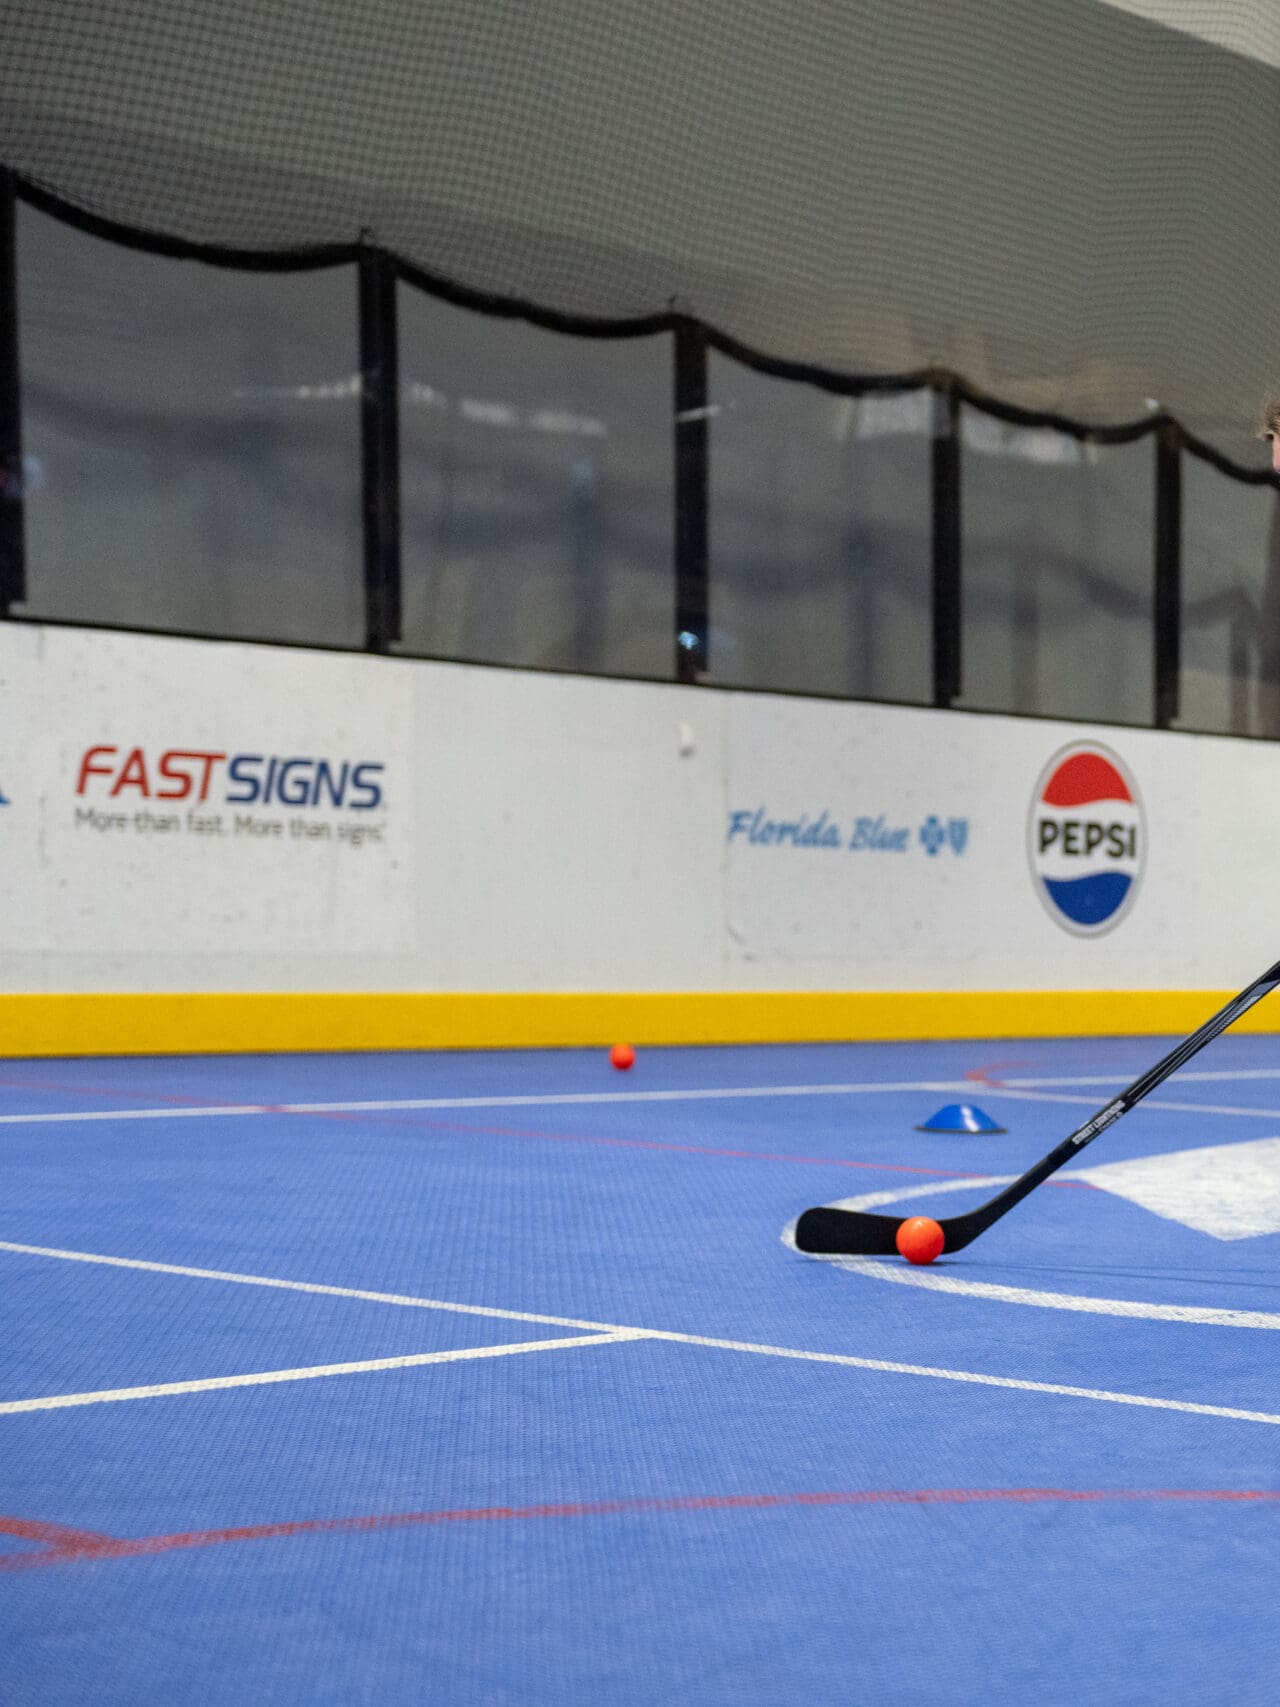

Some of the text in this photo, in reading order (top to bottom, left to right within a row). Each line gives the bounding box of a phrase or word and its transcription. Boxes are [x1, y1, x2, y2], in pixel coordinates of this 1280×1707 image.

[76, 745, 385, 810] FASTSIGNS
[75, 806, 127, 832] More
[134, 808, 180, 833] than
[234, 813, 282, 836] More
[290, 816, 330, 840] than
[728, 808, 909, 851] Florida Blue
[1038, 819, 1137, 858] PEPSI
